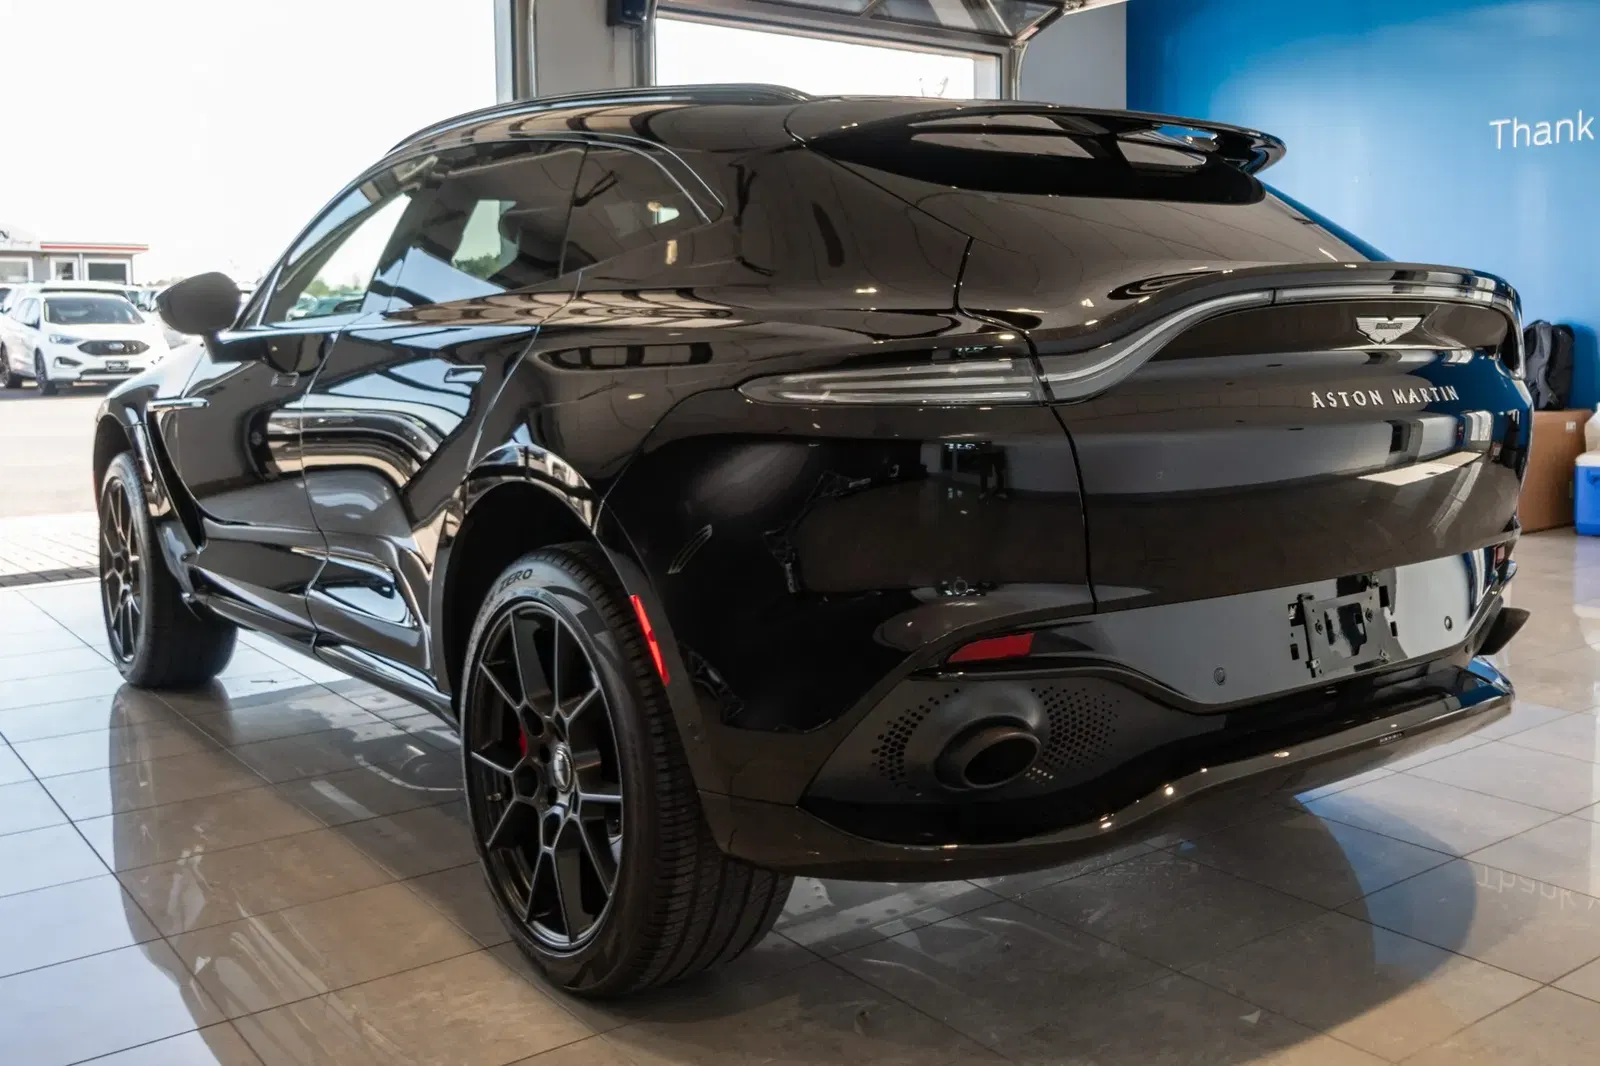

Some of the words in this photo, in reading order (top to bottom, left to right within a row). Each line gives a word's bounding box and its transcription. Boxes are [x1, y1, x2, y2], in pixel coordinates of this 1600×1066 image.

[1489, 109, 1594, 150] Thank
[1310, 390, 1383, 409] ASTON
[1391, 385, 1460, 404] MARTIN
[499, 568, 533, 594] ZERO
